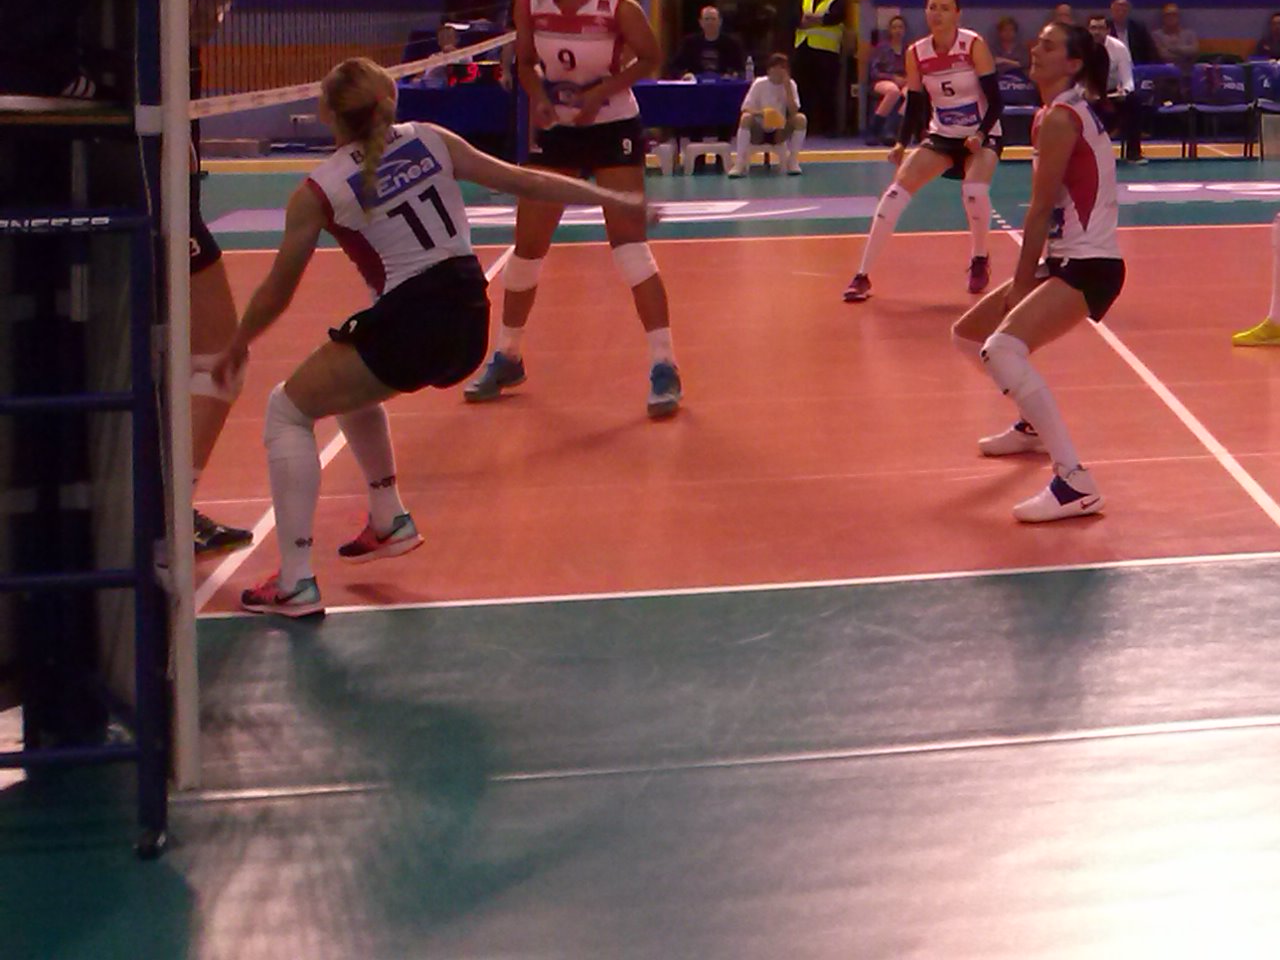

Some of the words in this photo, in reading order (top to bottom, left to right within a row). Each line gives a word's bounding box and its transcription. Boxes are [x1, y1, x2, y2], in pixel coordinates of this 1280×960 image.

[557, 48, 577, 72] 9
[941, 81, 956, 97] 5
[622, 138, 633, 155] 9
[376, 156, 436, 198] Enea
[386, 184, 457, 251] 11
